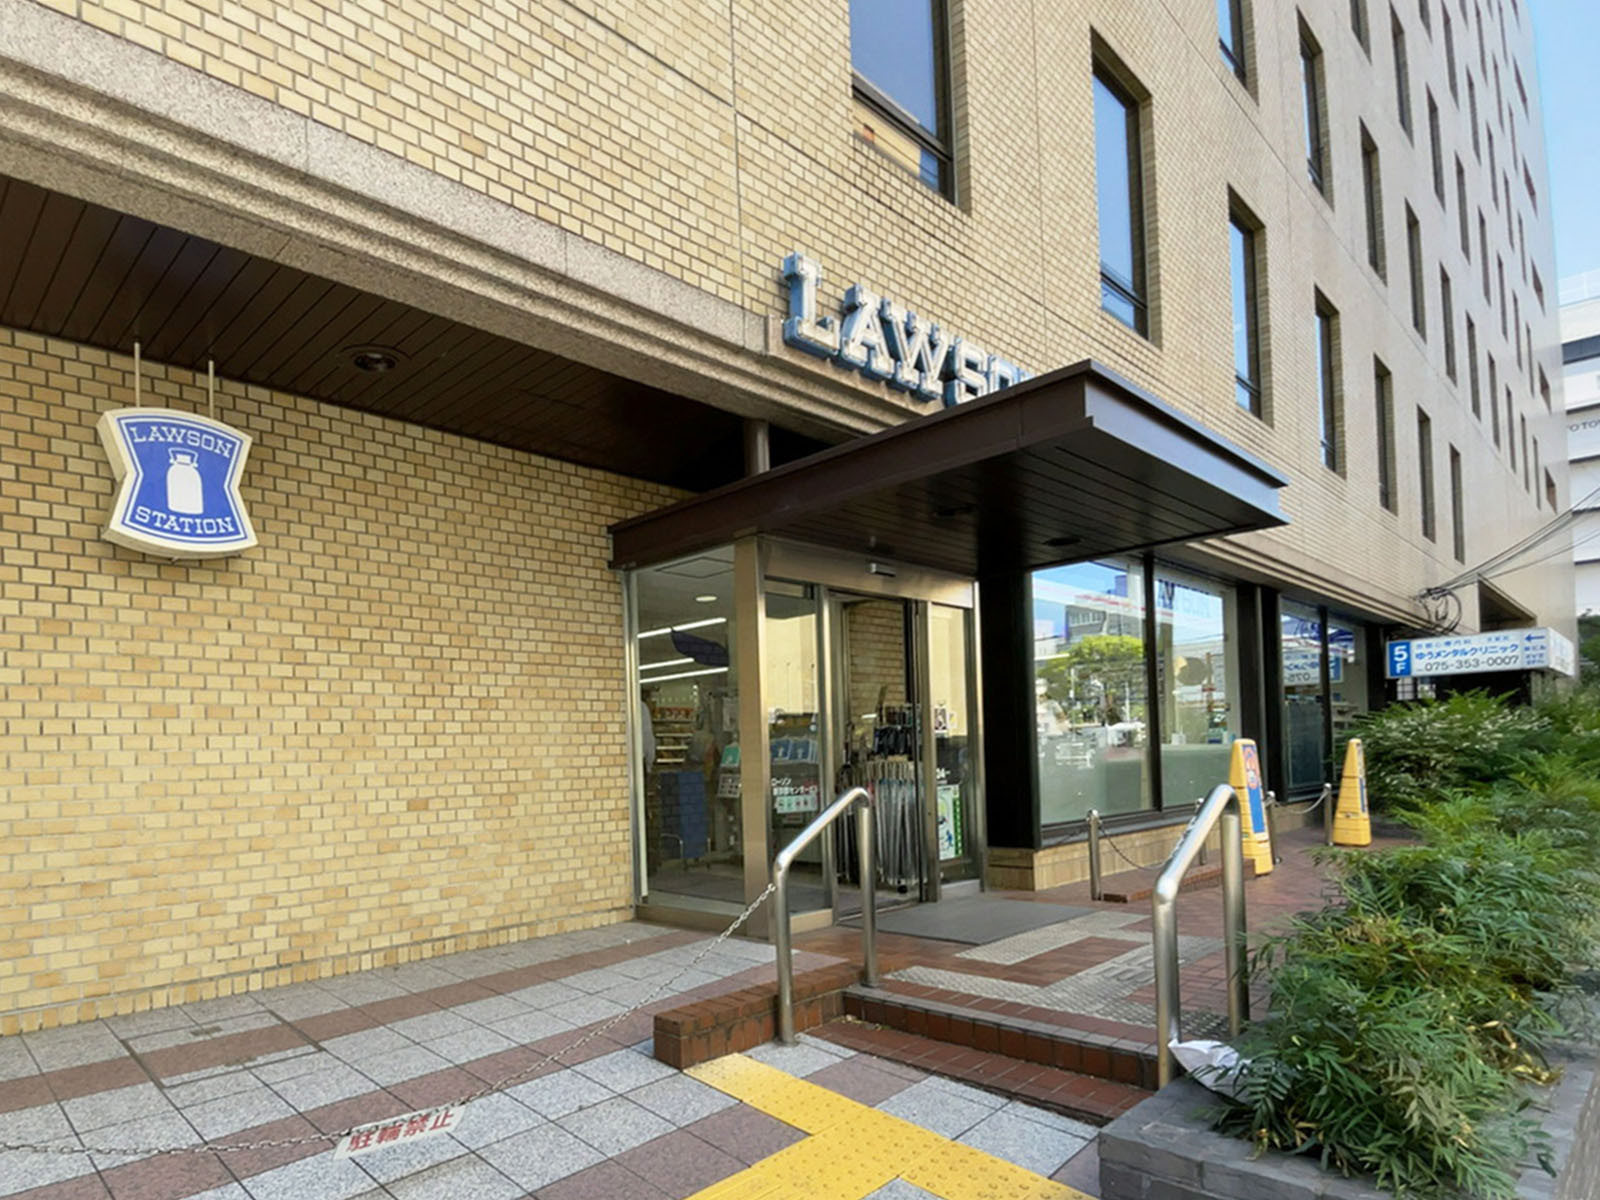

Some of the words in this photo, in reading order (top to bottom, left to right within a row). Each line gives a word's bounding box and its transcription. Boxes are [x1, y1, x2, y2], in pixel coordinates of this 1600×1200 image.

[783, 251, 1037, 407] LAWSO
[130, 425, 233, 459] LAWSON
[135, 505, 235, 535] STATION
[1416, 643, 1519, 661] ゆうメンタルクリニック
[1425, 655, 1519, 672] 075-353-0007
[347, 1109, 454, 1152] 駐輪禁止
